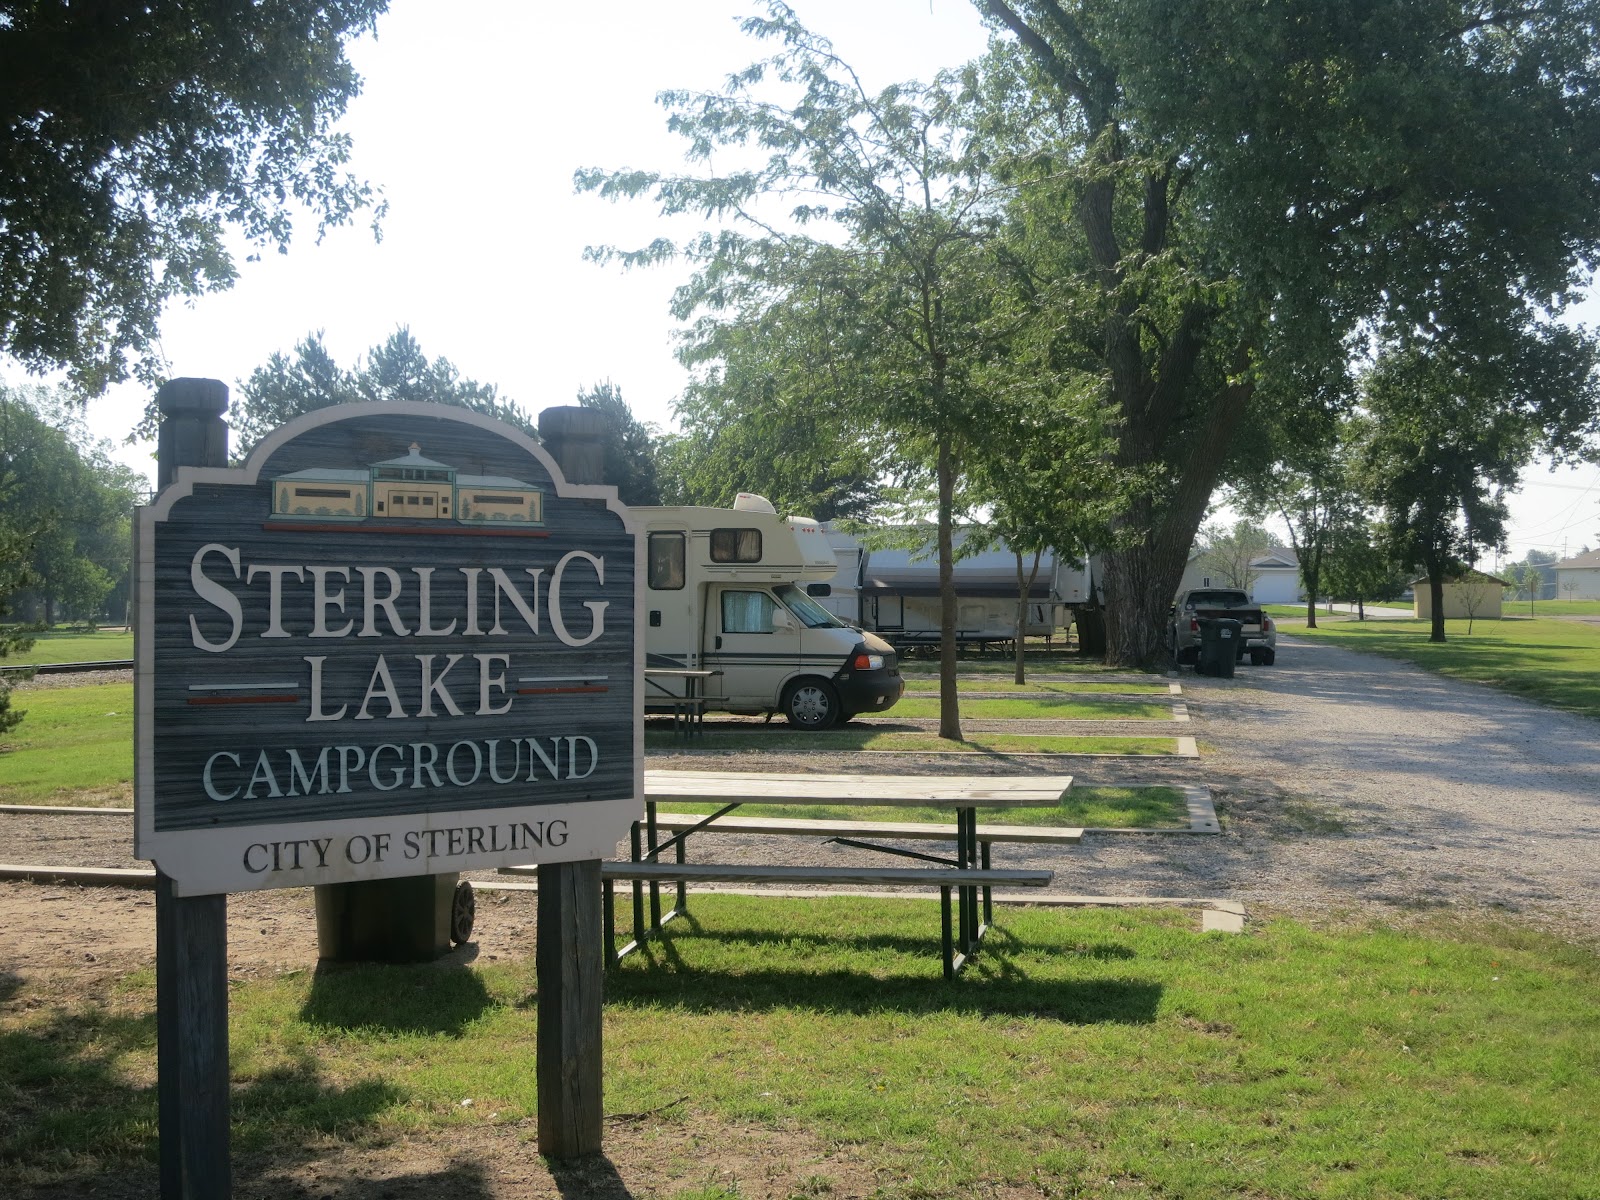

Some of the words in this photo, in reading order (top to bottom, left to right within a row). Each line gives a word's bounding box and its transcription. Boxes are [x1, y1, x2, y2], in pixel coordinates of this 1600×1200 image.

[189, 543, 610, 653] STERLING
[305, 653, 513, 722] LAKE
[203, 735, 599, 802] CAMPGROUND
[243, 838, 333, 874] CITY
[345, 834, 391, 864] OF
[403, 820, 569, 859] STERLING
